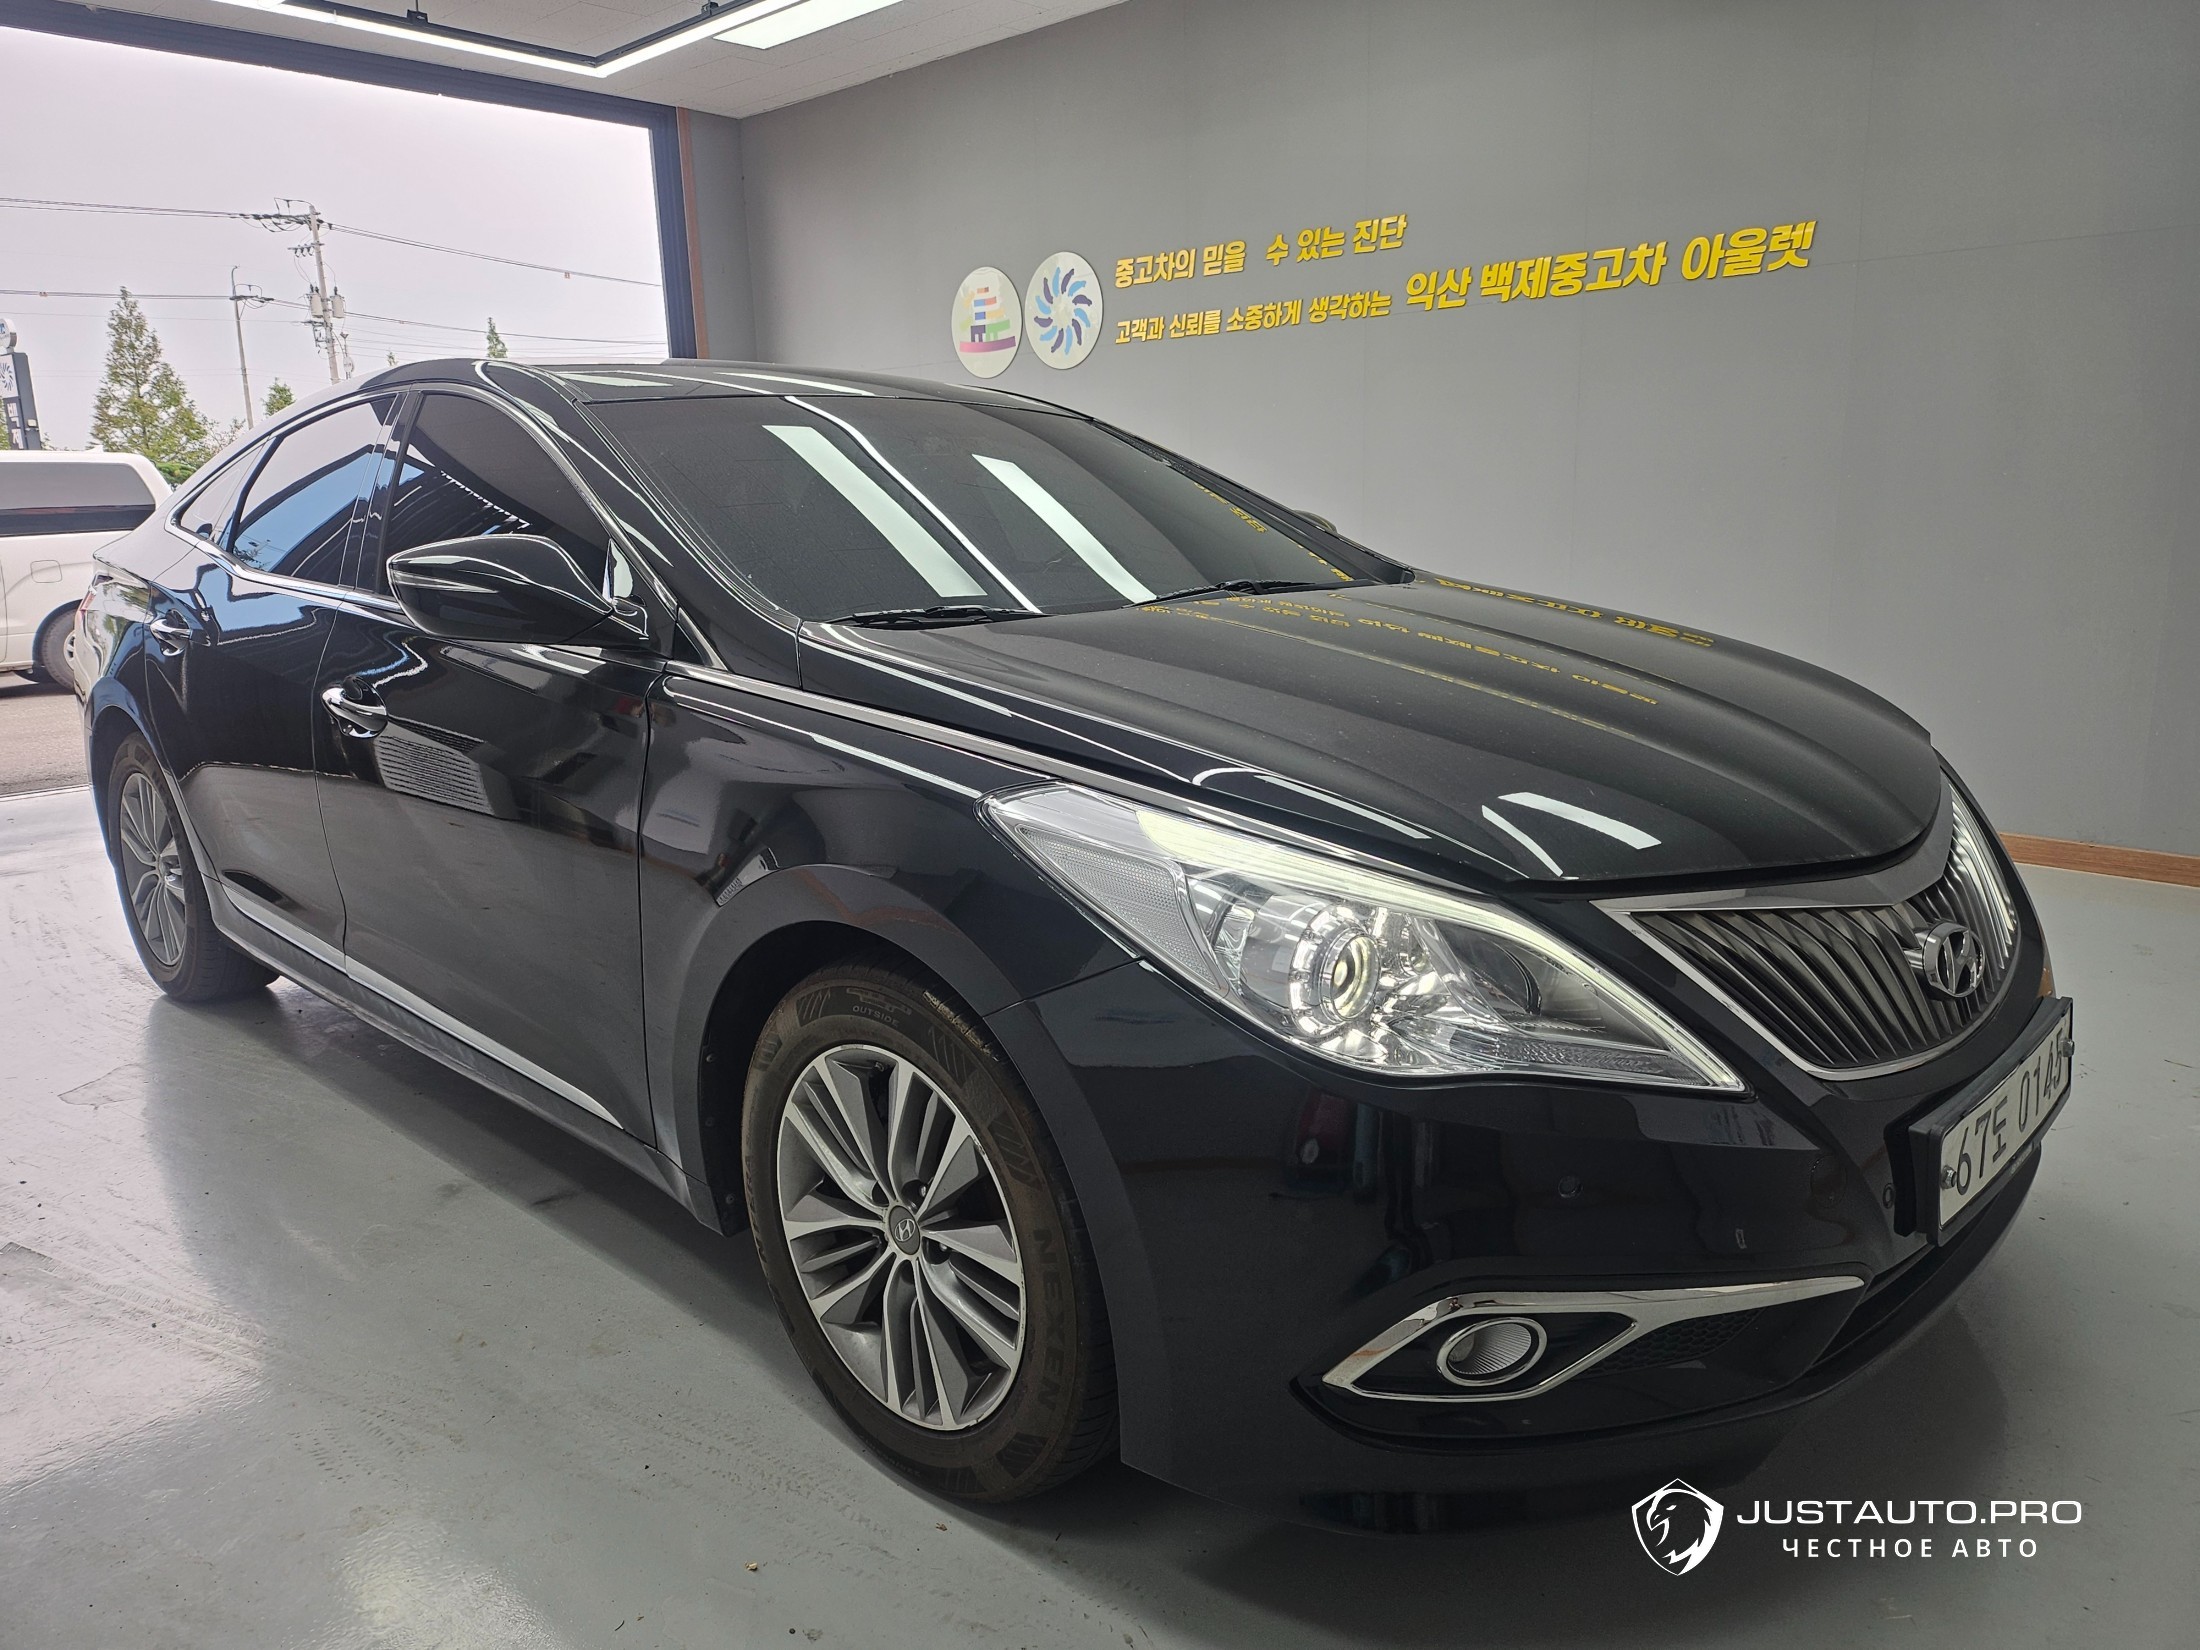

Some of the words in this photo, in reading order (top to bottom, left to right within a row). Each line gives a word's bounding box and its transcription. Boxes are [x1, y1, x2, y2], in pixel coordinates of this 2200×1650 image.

[1115, 249, 1195, 289] 중고차의
[1202, 240, 1246, 277] 믿을
[1265, 233, 1289, 267] 수
[1296, 226, 1346, 263] 있는
[1352, 213, 1408, 254] 진단
[1115, 317, 1165, 344] 고객과
[1168, 312, 1222, 339] 신뢰를
[1226, 299, 1303, 333] 소중하게
[1308, 290, 1393, 323] 생각하는
[1405, 266, 1473, 312] 익산
[1479, 239, 1669, 303] 백제중고차
[1680, 219, 1817, 281] 아울렛
[852, 1004, 900, 1028] OUTSIDE
[1956, 1096, 2008, 1196] 67도
[2018, 1027, 2064, 1133] 0145
